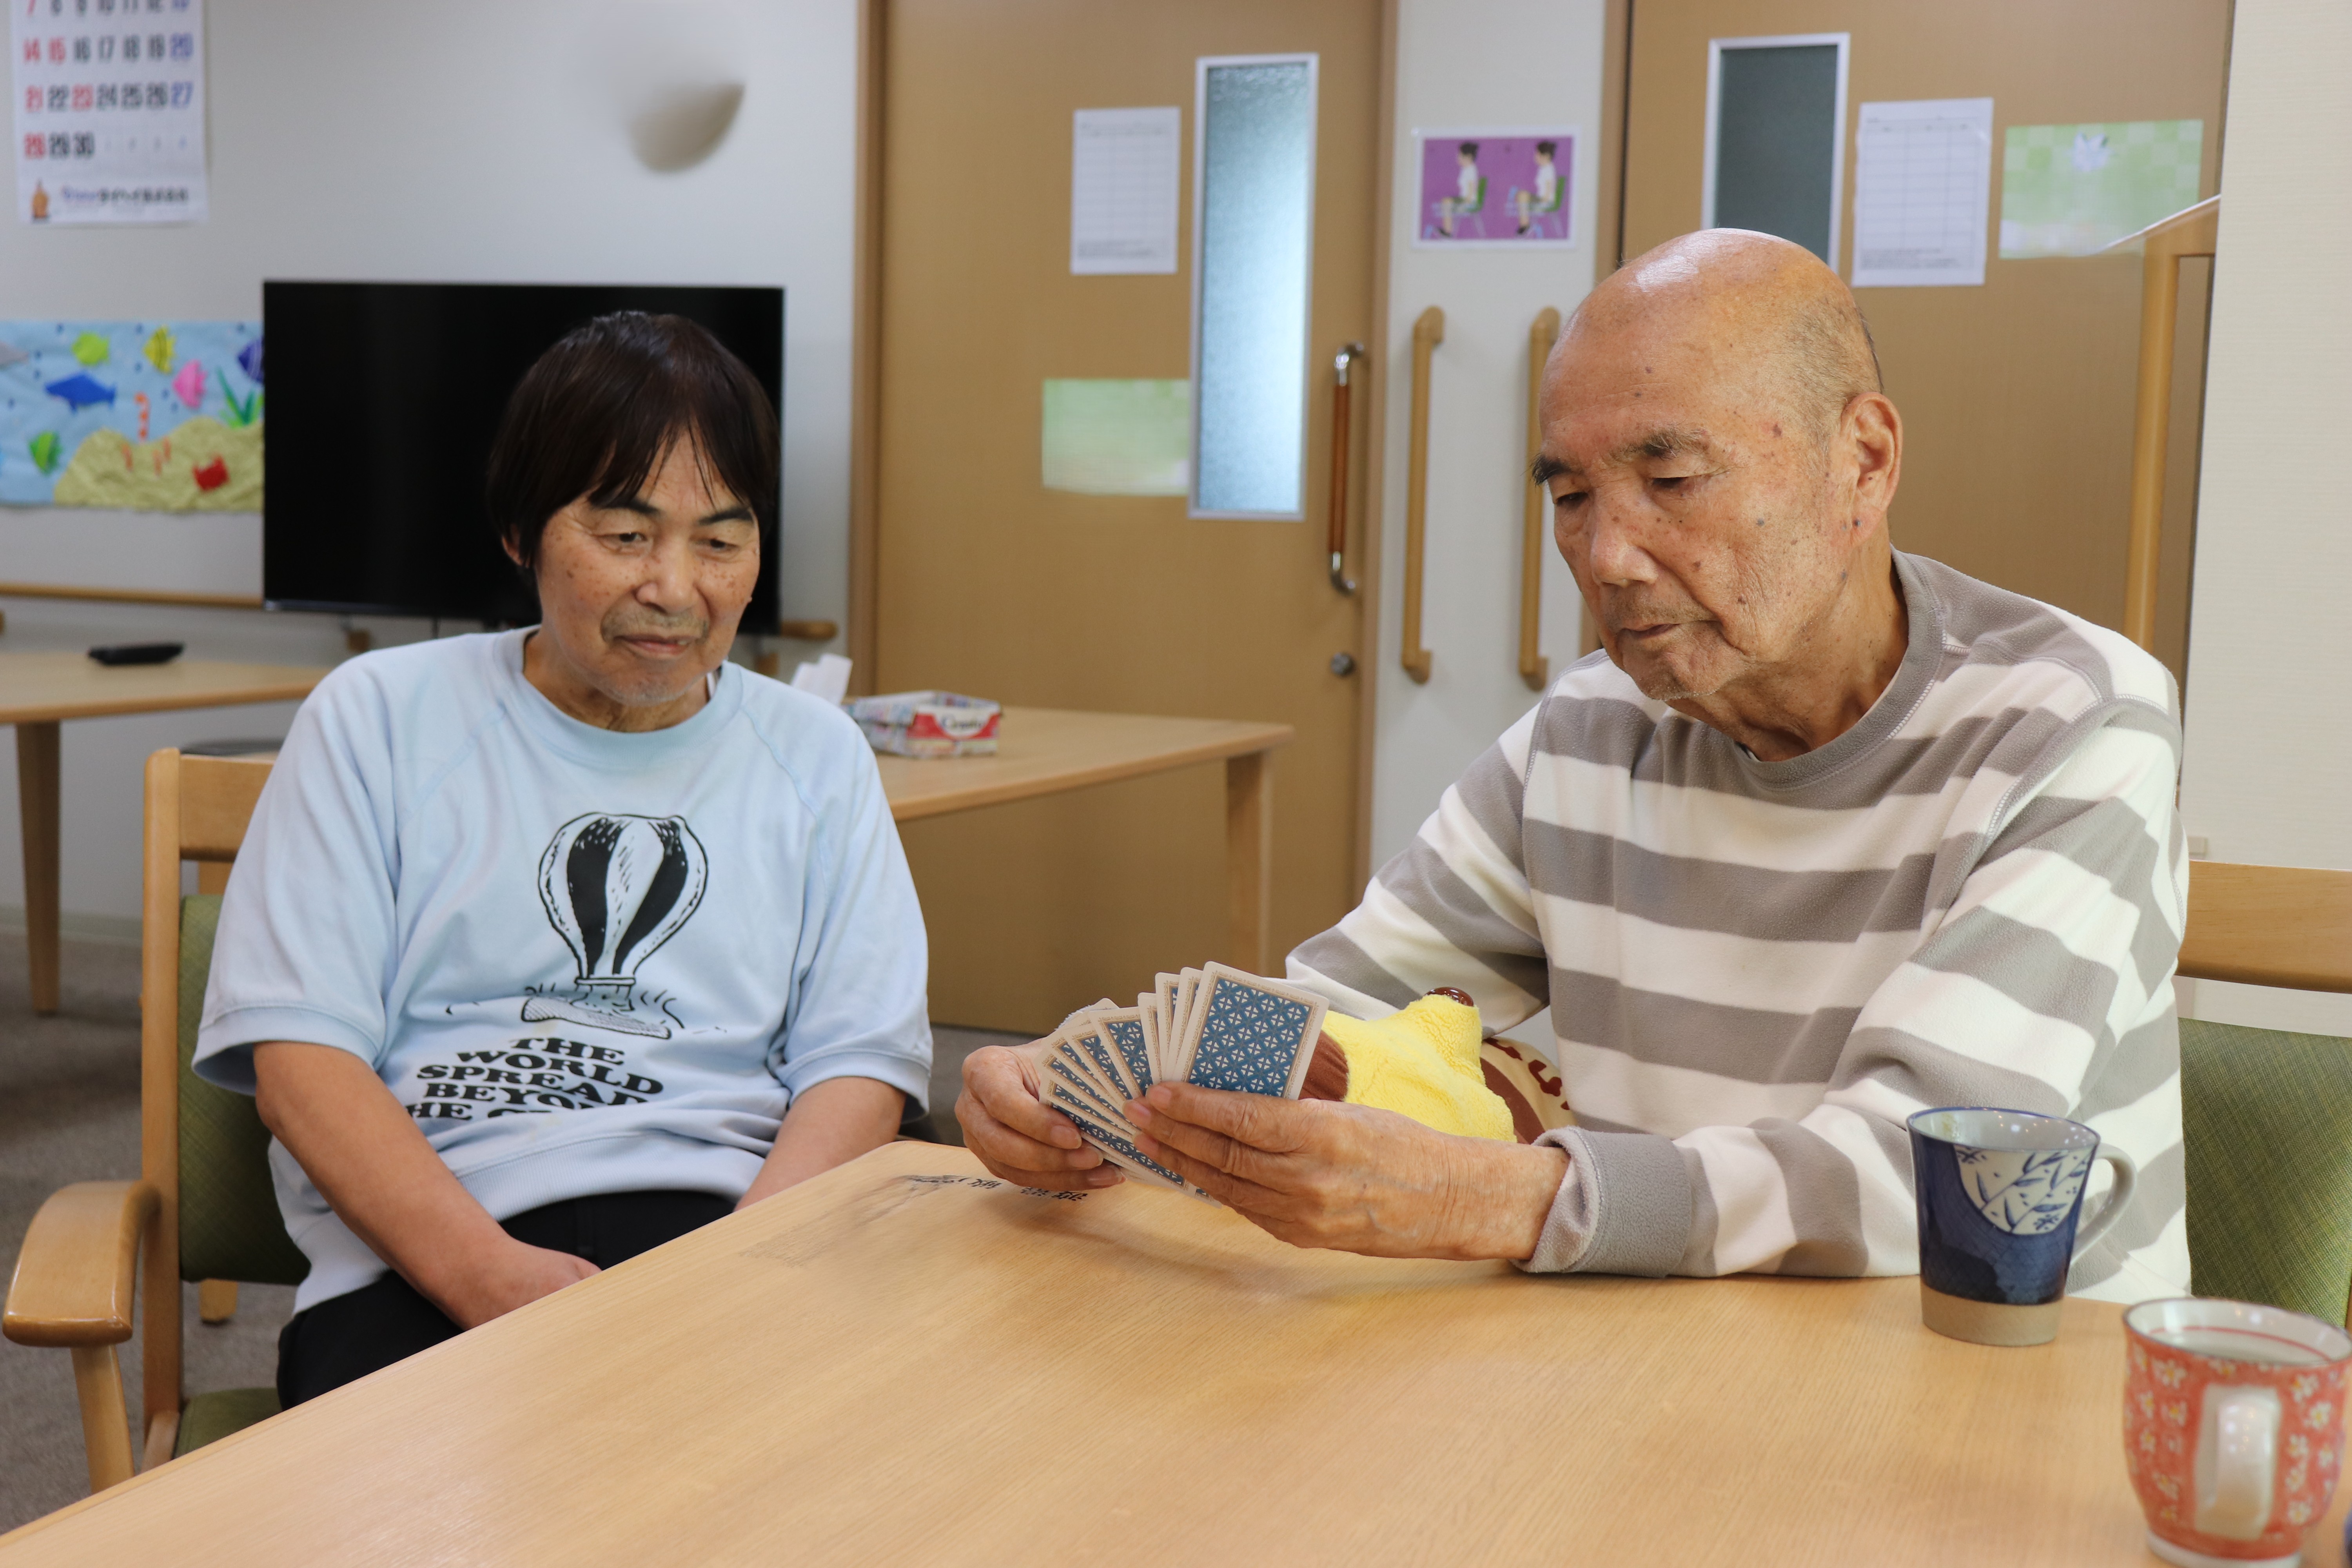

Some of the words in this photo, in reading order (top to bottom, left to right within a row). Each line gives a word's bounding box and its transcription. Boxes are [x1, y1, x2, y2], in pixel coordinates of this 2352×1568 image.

[24, 38, 41, 62] 14
[74, 37, 91, 63] 16
[99, 36, 114, 60] 17
[171, 34, 193, 58] 20
[26, 86, 43, 111] 21
[48, 86, 69, 111] 22
[73, 86, 93, 110] 23
[97, 84, 118, 110] 24
[122, 84, 143, 109] 25
[146, 83, 168, 108] 26
[172, 82, 193, 106] 27
[73, 132, 95, 158] 30
[510, 1038, 625, 1065] THE
[456, 1051, 664, 1094] WORLD
[424, 1083, 594, 1109] BEYO
[405, 1102, 472, 1120] HE
